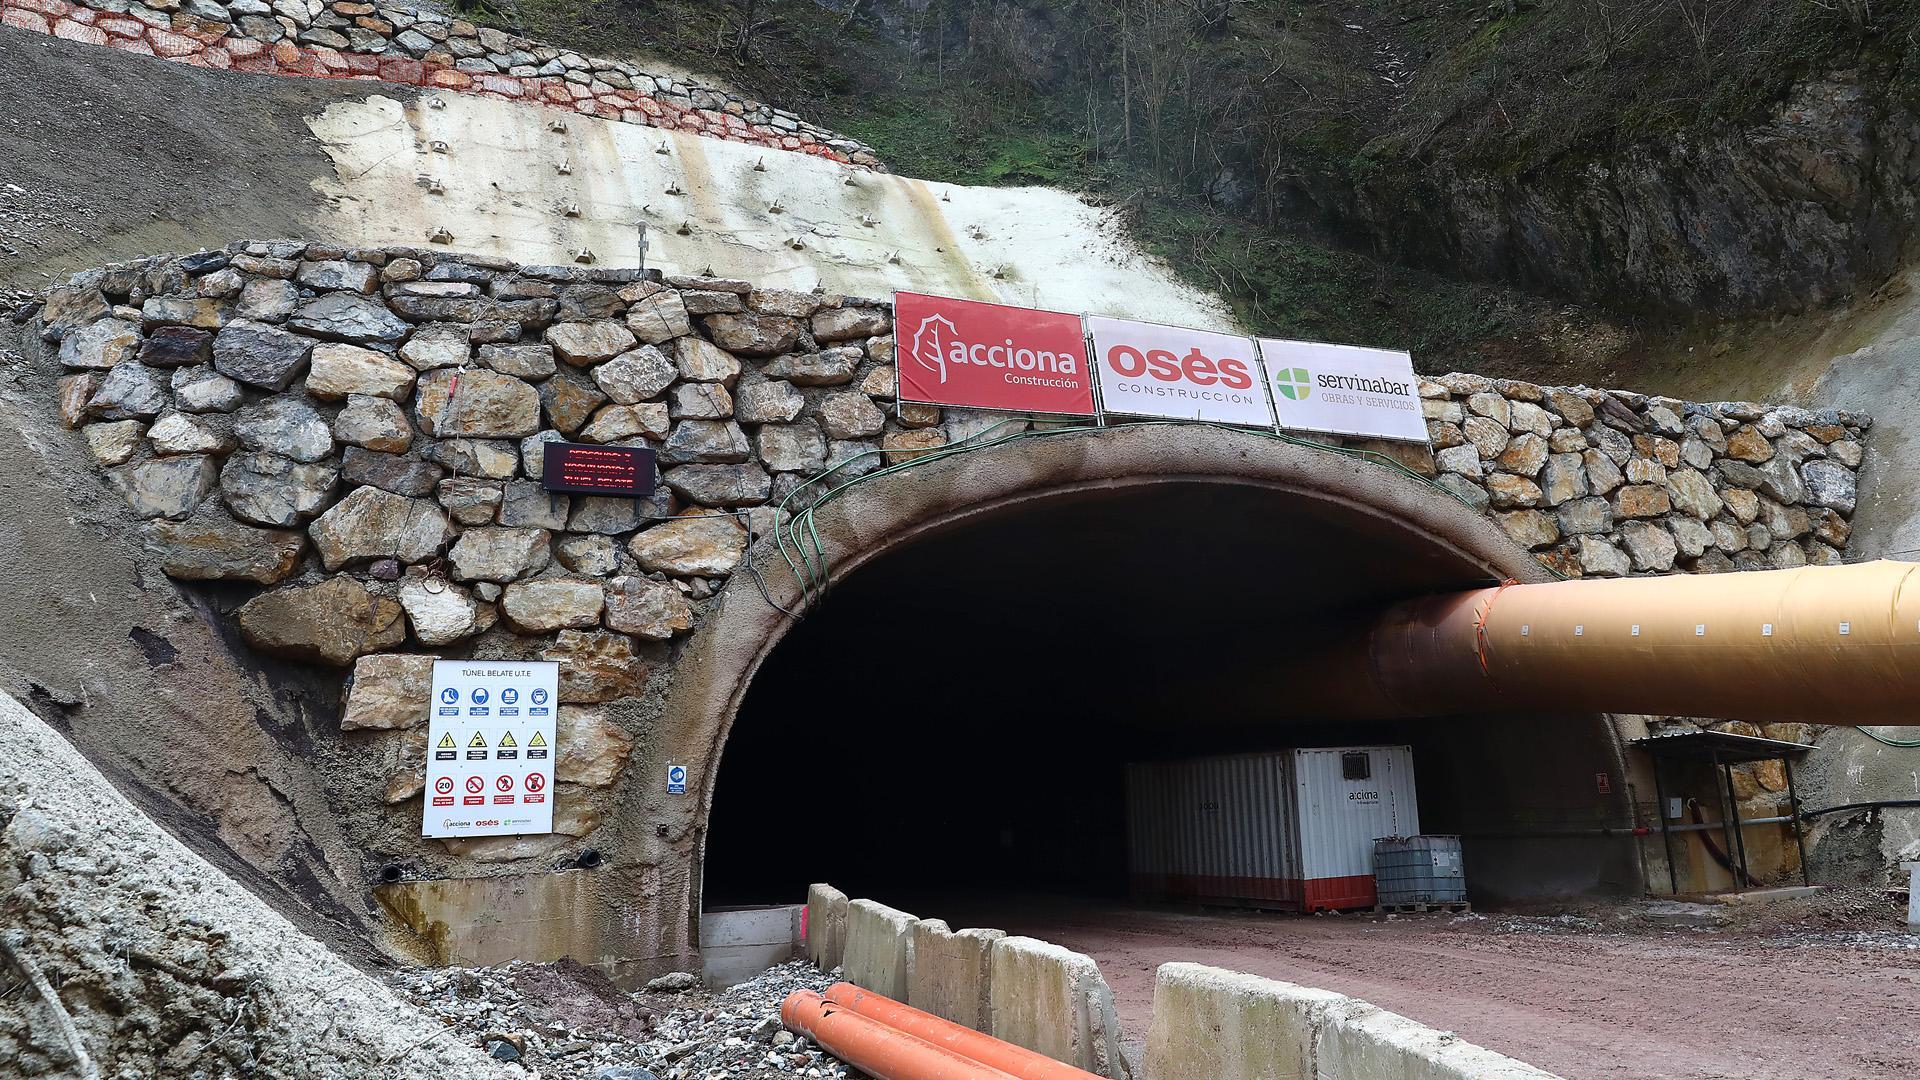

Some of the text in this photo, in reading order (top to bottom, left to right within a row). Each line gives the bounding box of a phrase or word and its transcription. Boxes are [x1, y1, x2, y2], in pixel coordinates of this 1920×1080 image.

[949, 338, 1077, 375] acciona
[1004, 373, 1079, 389] Construcción
[1317, 374, 1410, 396] servinabar
[1321, 392, 1415, 411] OBRAS Y SERVICIOS
[462, 668, 486, 677] TÚNEL
